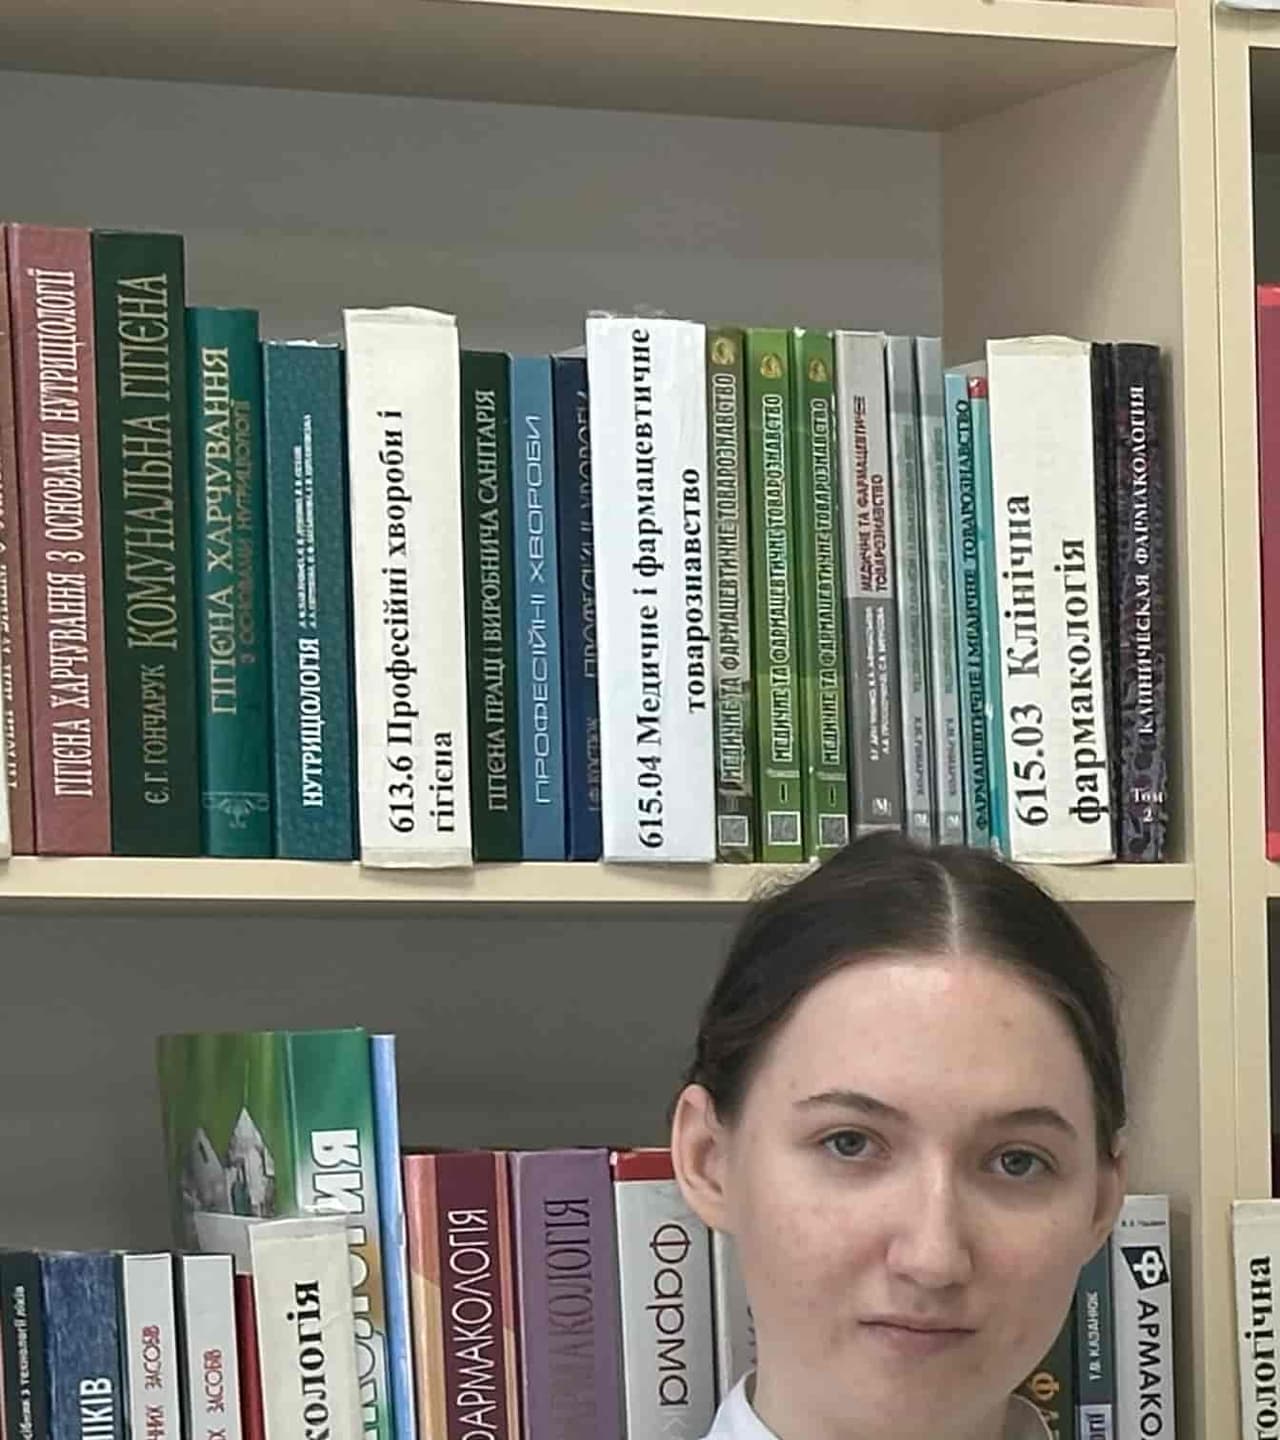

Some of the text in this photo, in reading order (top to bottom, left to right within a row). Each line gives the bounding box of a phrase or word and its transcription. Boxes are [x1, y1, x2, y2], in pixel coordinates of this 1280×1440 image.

[28, 267, 93, 797] ГІГІЄНА ХАРЧУВАННЯ З ОСНОВАМИ НУТРИЦІОЛОГІЇ
[117, 273, 178, 650] КОМУНАЛЬНА ГІГІЄНА
[202, 347, 237, 715] ГІГІЄНА ХАРЧУВАННЯ
[474, 389, 498, 504] САНІТАРІЯ
[478, 508, 503, 641] ВИРОБНИЧА
[712, 374, 744, 781] МЕДИЧНЕ ТА ФАРМАЦЕВТИЧНЕ ТОВАРОЗНАВСТВО
[762, 395, 793, 762] МЕДИЧНЕ ТА ФАРМАЦЕВТИЧНЕ ТОВАРОЗНАВСТВО
[811, 399, 834, 529] ТОВАРОЗНАВСТВО
[1129, 386, 1154, 735] КЛИНИЧЕСКАЯ ФАРМАКОЛОГИЯ
[377, 410, 419, 833] 613.6 Професійні хвороби і
[525, 414, 551, 805] ПРОФЕСІЙНІ ХВОРОБИ
[631, 328, 664, 848] 615.04 Медичне і фармацевтичне
[681, 468, 711, 713] товарознавство
[816, 532, 836, 667] ФАРМАЦЕВТИЧНЕ
[819, 668, 838, 689] ТА
[1006, 495, 1050, 828] 615.03 Клінічна
[1060, 538, 1104, 827] фармакологія
[299, 637, 326, 808] НУТРИЦІОЛОГІЯ
[429, 731, 456, 833] гігієна
[487, 728, 508, 811] ГІГІЄНА
[143, 1325, 161, 1389] ЗАСОБІВ
[204, 1348, 225, 1413] ЗАСОБІВ
